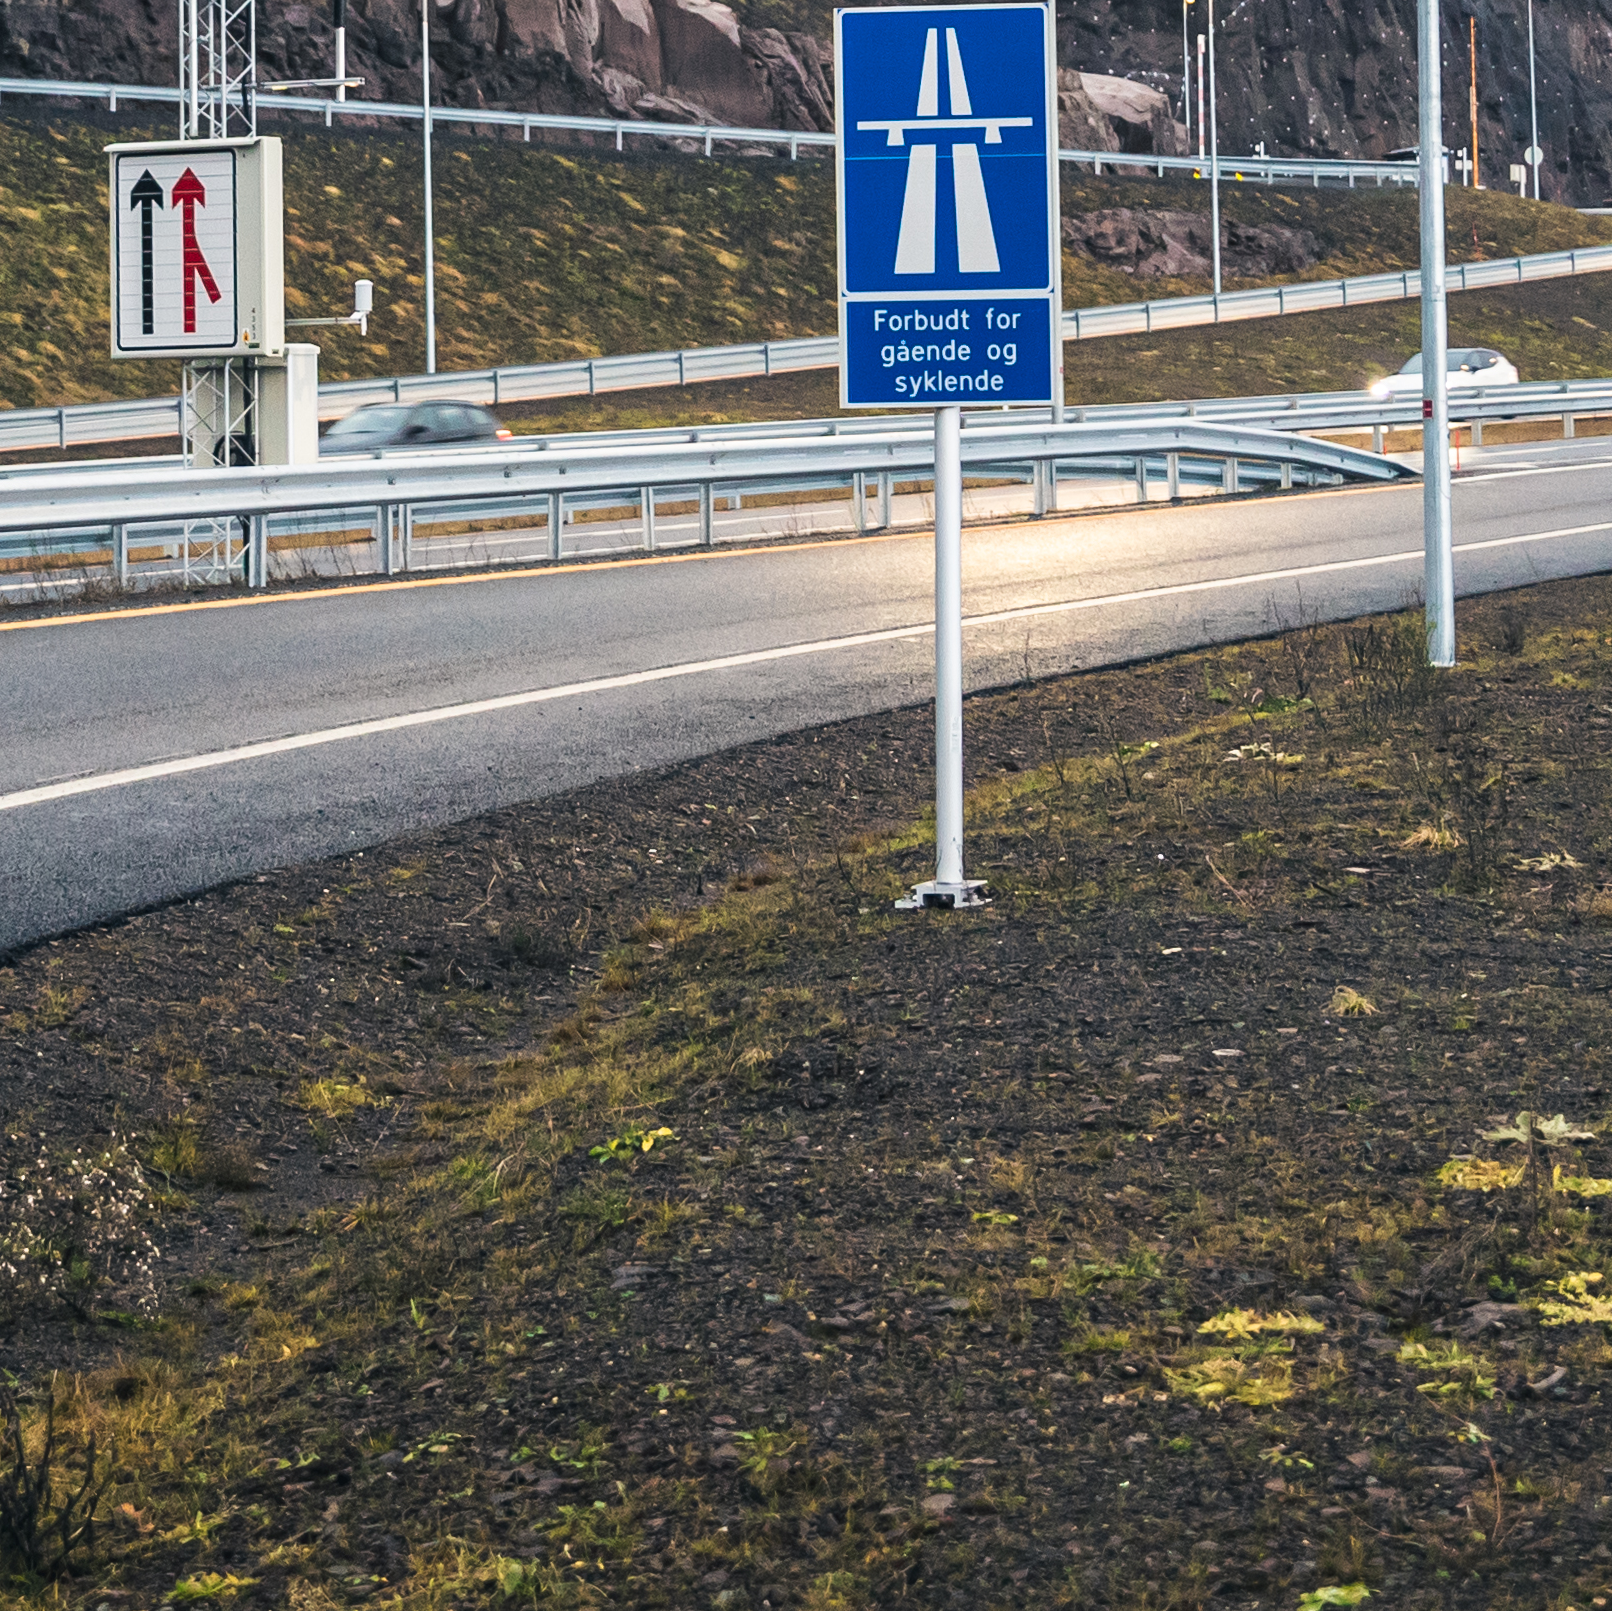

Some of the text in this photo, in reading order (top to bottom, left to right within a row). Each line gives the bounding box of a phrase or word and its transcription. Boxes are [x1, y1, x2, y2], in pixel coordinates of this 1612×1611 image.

[873, 307, 1022, 331] Forbudt for
[880, 339, 1017, 367] gående og
[895, 369, 1004, 398] syklende
